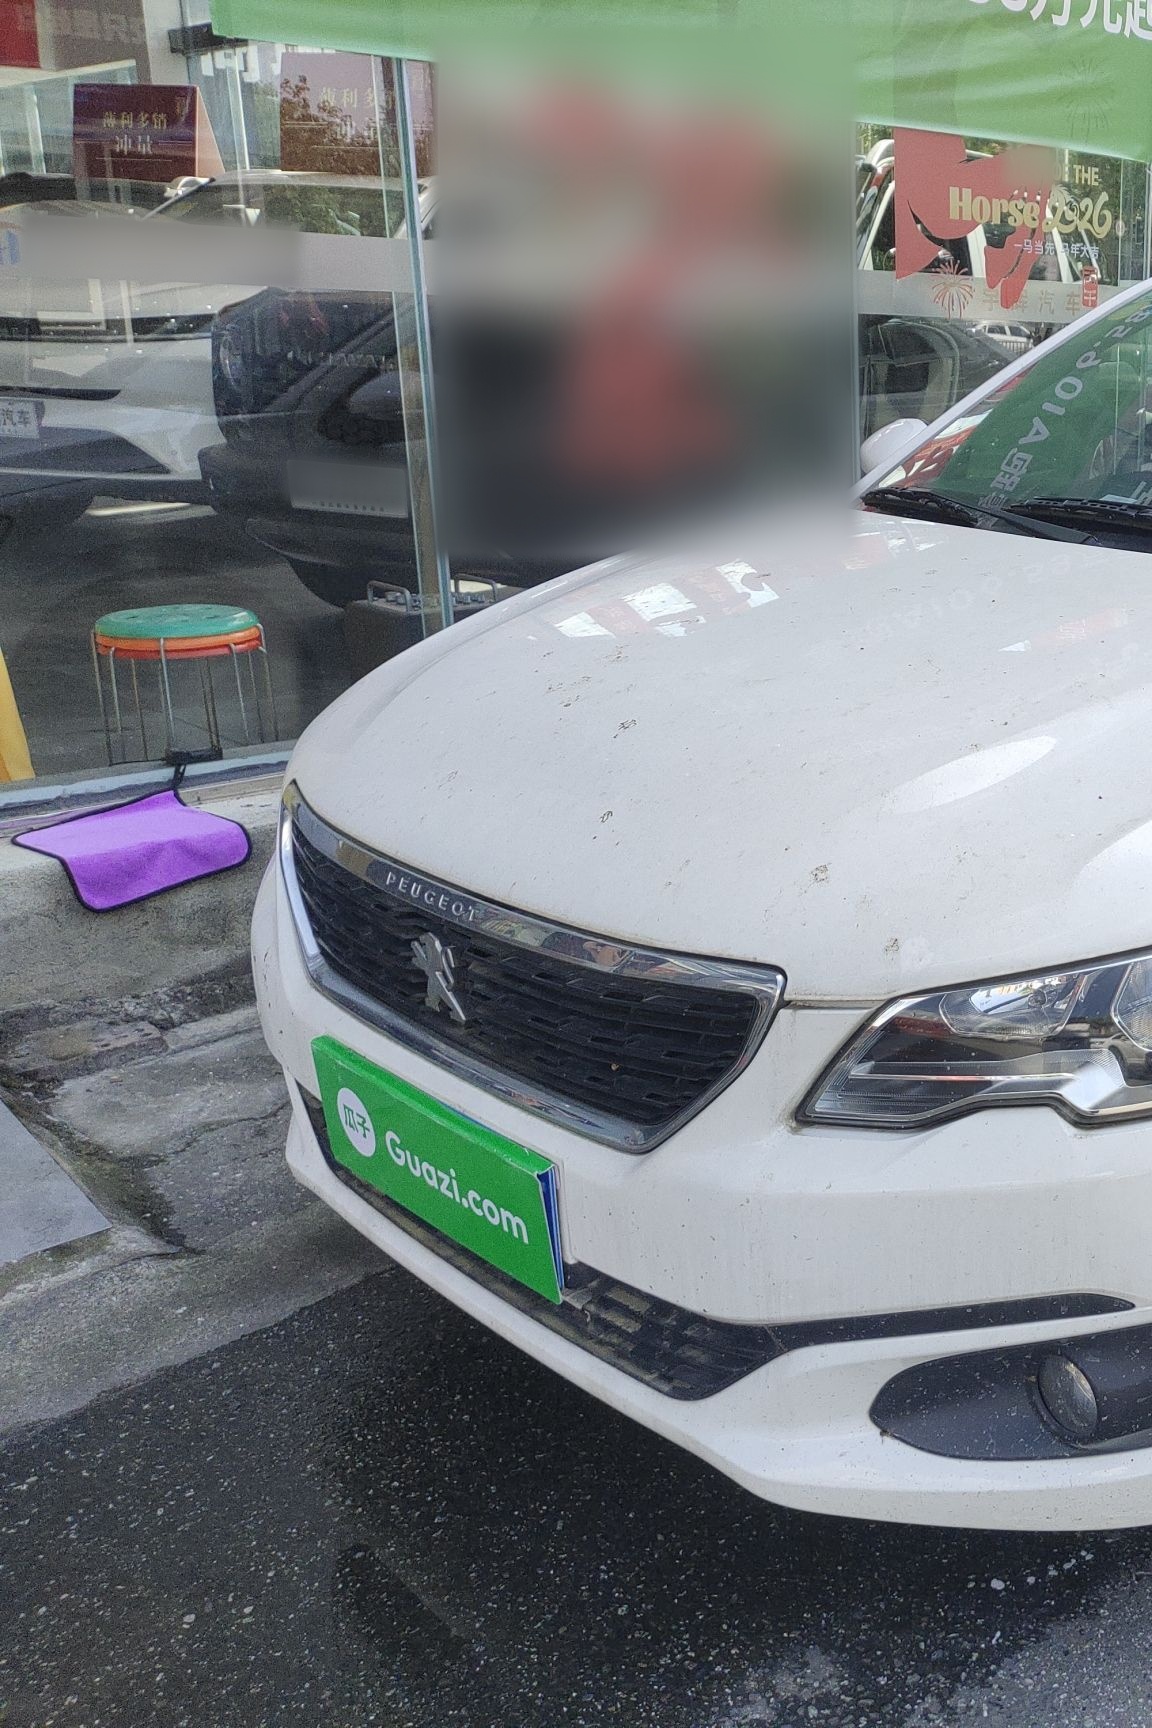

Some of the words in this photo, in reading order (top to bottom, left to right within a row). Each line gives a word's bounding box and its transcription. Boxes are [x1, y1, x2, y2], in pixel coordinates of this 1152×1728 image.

[1073, 165, 1099, 186] THE
[949, 186, 1041, 229] Horse
[1013, 238, 1056, 256] 一马当先
[385, 871, 480, 921] PEUGEOT
[342, 1103, 371, 1139] 瓜子
[385, 1130, 529, 1245] Guazi.com
